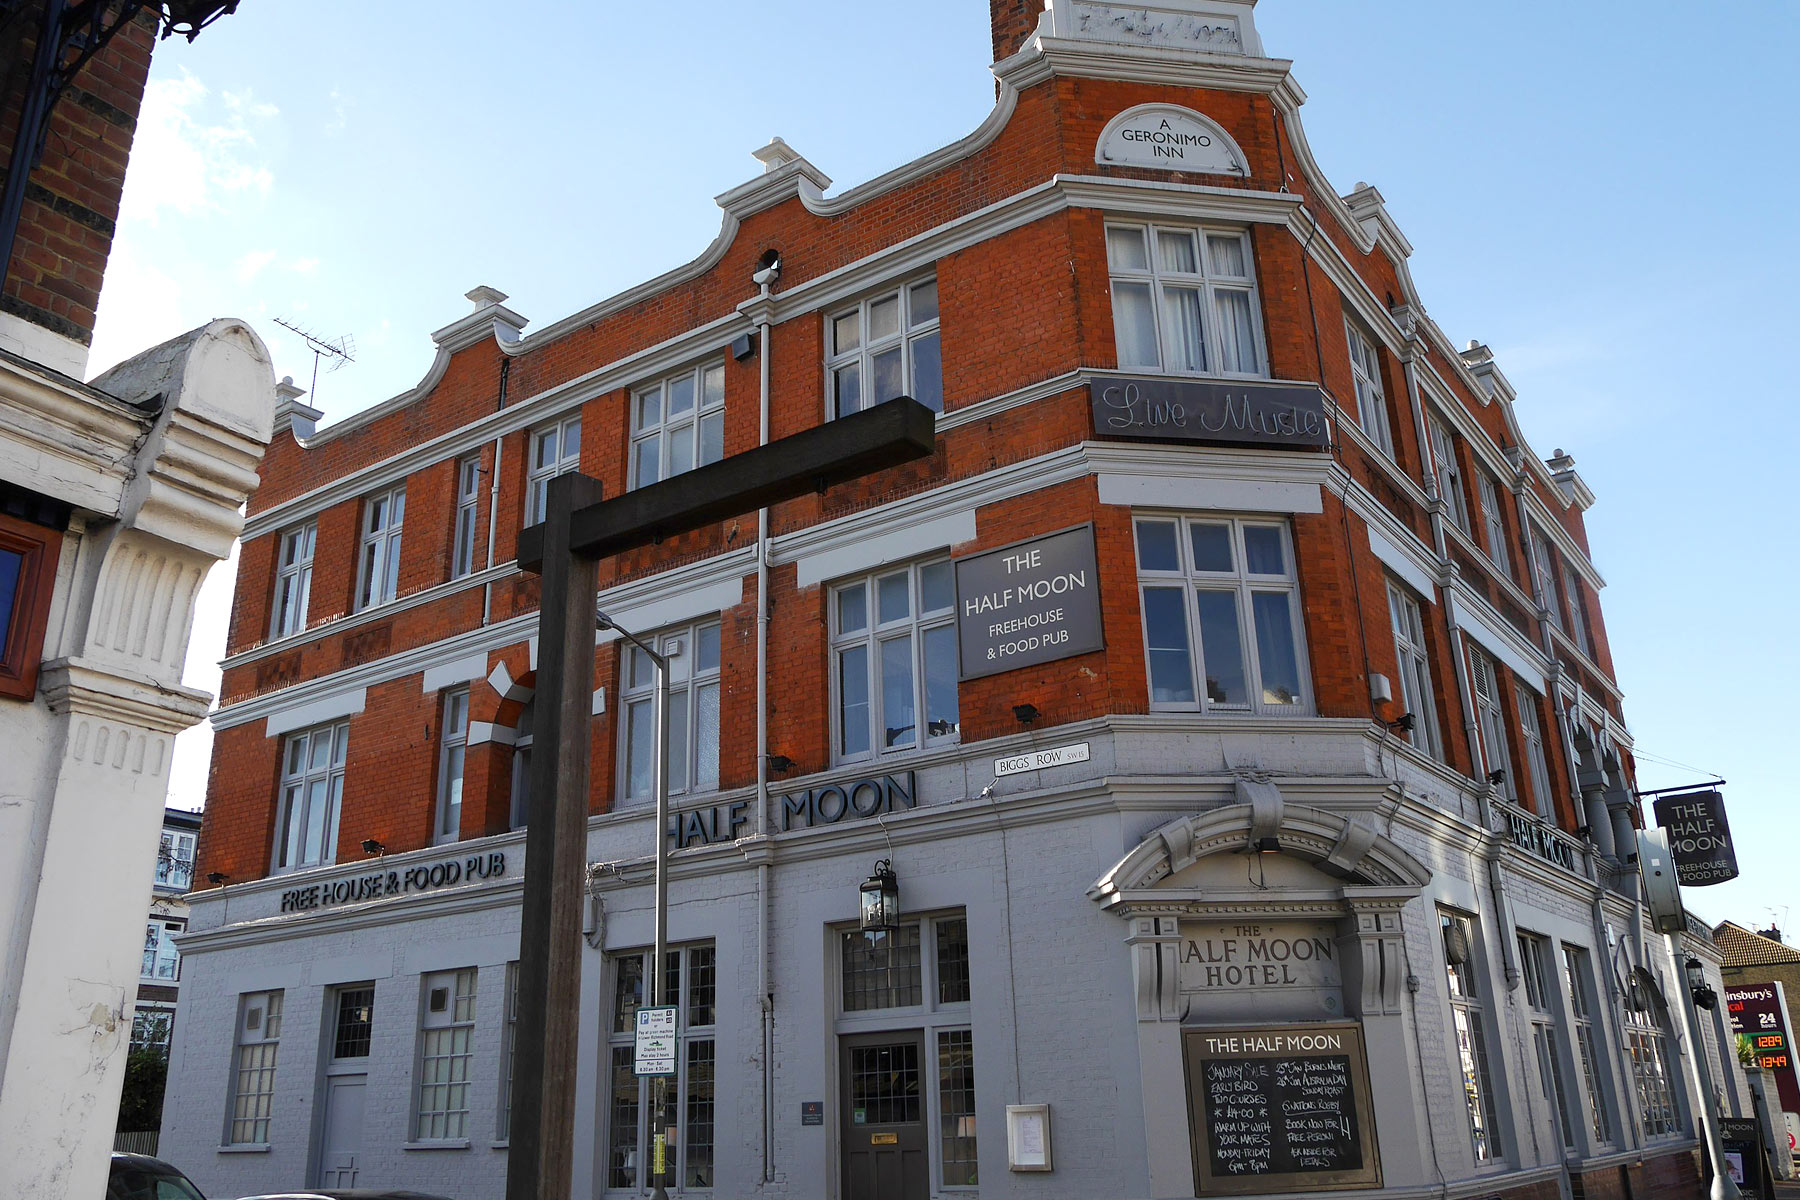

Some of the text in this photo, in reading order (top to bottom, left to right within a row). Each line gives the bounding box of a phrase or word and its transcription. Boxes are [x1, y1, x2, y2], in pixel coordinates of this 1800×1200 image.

[1160, 118, 1171, 131] A
[1122, 129, 1212, 147] GERONIMO
[1152, 145, 1184, 160] INN
[1102, 383, 1321, 436] Live Music
[1003, 549, 1042, 574] THE
[965, 570, 1086, 617] HALF MOON
[989, 608, 1064, 638] FREEHOUSE
[987, 630, 1069, 660] & FOOD PUB
[1000, 757, 1030, 772] BIGGS
[1036, 751, 1062, 766] ROW
[781, 770, 917, 831] MOON
[1672, 802, 1708, 820] THE
[1672, 818, 1715, 837] HALF
[1510, 813, 1575, 872] HALF MOON
[1670, 834, 1727, 854] MOON
[281, 852, 505, 912] FREE HOUSE & FOOD PUB
[1683, 871, 1711, 882] FOOD
[1713, 868, 1732, 878] PUB
[1233, 926, 1262, 936] THE
[1248, 938, 1334, 962] MOON
[1206, 964, 1298, 986] HOTEL
[1726, 988, 1773, 1001] insbury's
[1728, 1001, 1744, 1012] cal
[1758, 1012, 1776, 1024] 24
[1206, 1034, 1341, 1054] THE HALF MOON
[1208, 1063, 1243, 1080] JANUARY
[1211, 1081, 1258, 1094] EARLY BIRD
[1229, 1094, 1267, 1104] COURSES
[1214, 1121, 1272, 1134] WARM UP WITH
[1324, 1118, 1340, 1130] FOR
[1220, 1134, 1270, 1146] YOUR MATES
[1286, 1133, 1306, 1143] FREE
